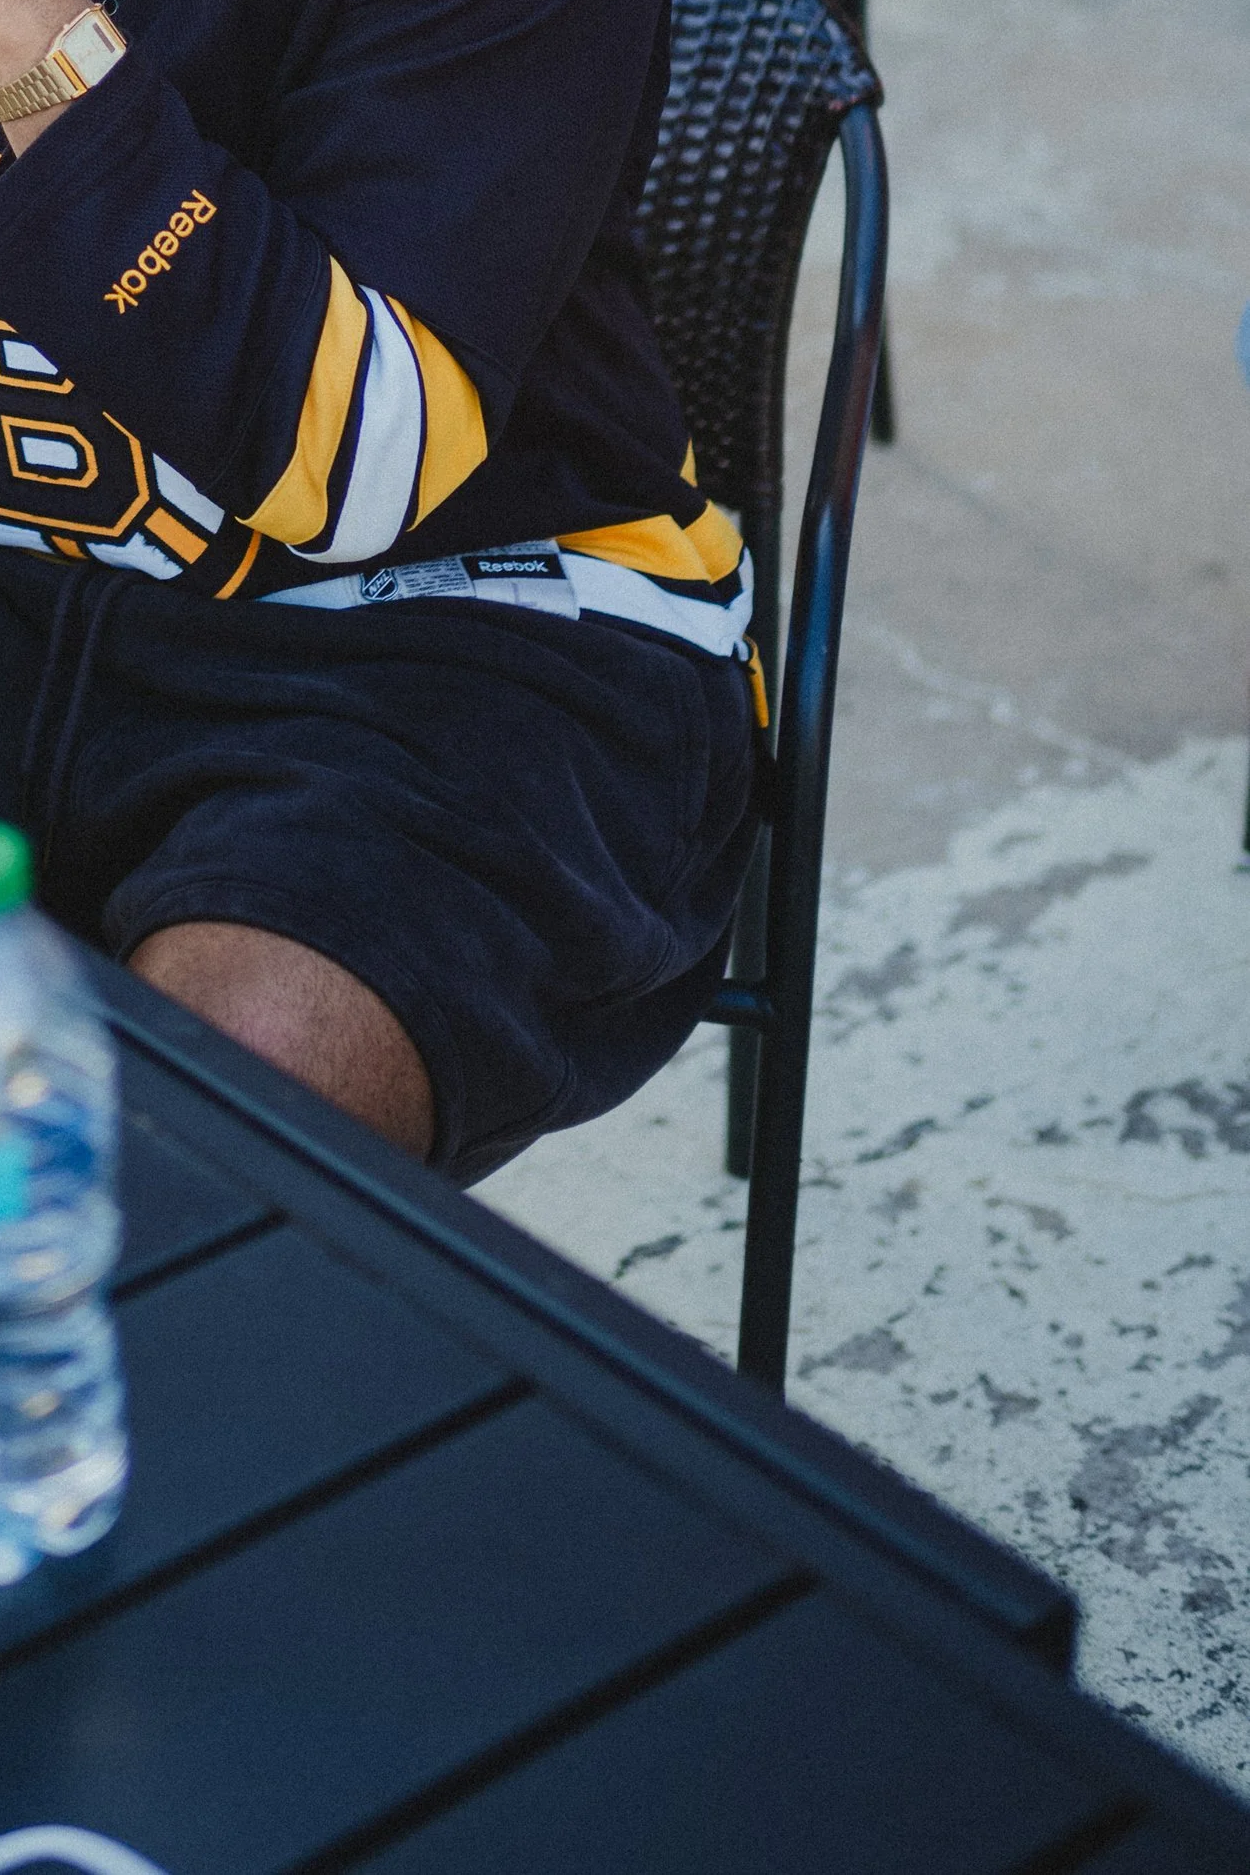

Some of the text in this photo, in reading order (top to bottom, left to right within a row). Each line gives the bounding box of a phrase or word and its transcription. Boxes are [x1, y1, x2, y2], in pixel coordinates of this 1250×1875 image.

[102, 188, 218, 315] Reebok
[477, 559, 549, 573] Reebok
[368, 572, 391, 596] NHL
